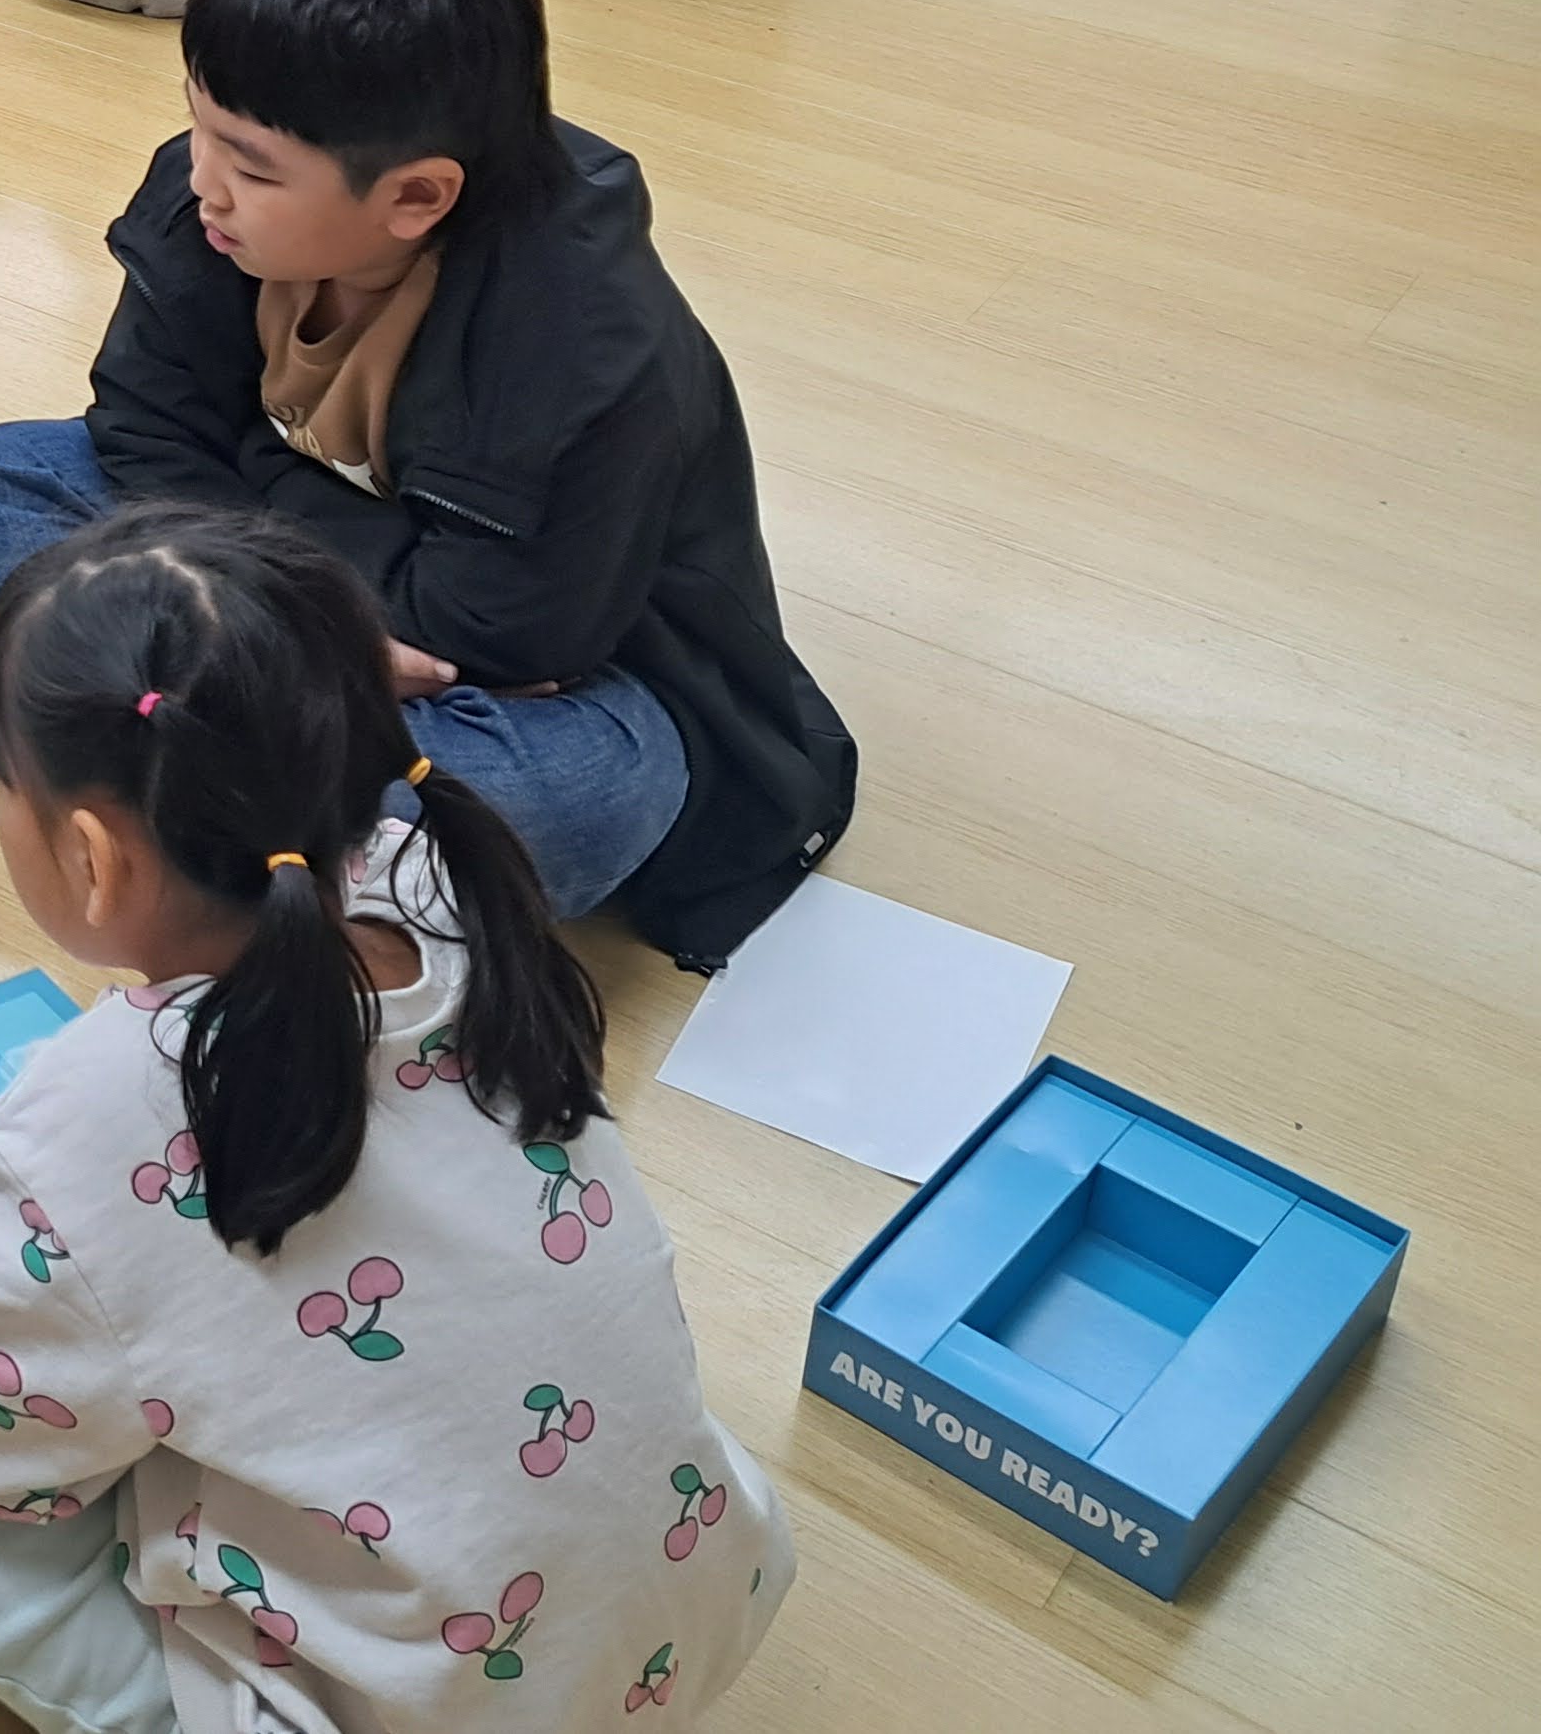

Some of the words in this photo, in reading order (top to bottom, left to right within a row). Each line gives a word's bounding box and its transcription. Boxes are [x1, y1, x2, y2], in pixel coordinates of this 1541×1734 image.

[830, 1351, 905, 1413] ARE
[912, 1393, 993, 1461] YOU
[1000, 1448, 1160, 1558] READY?
